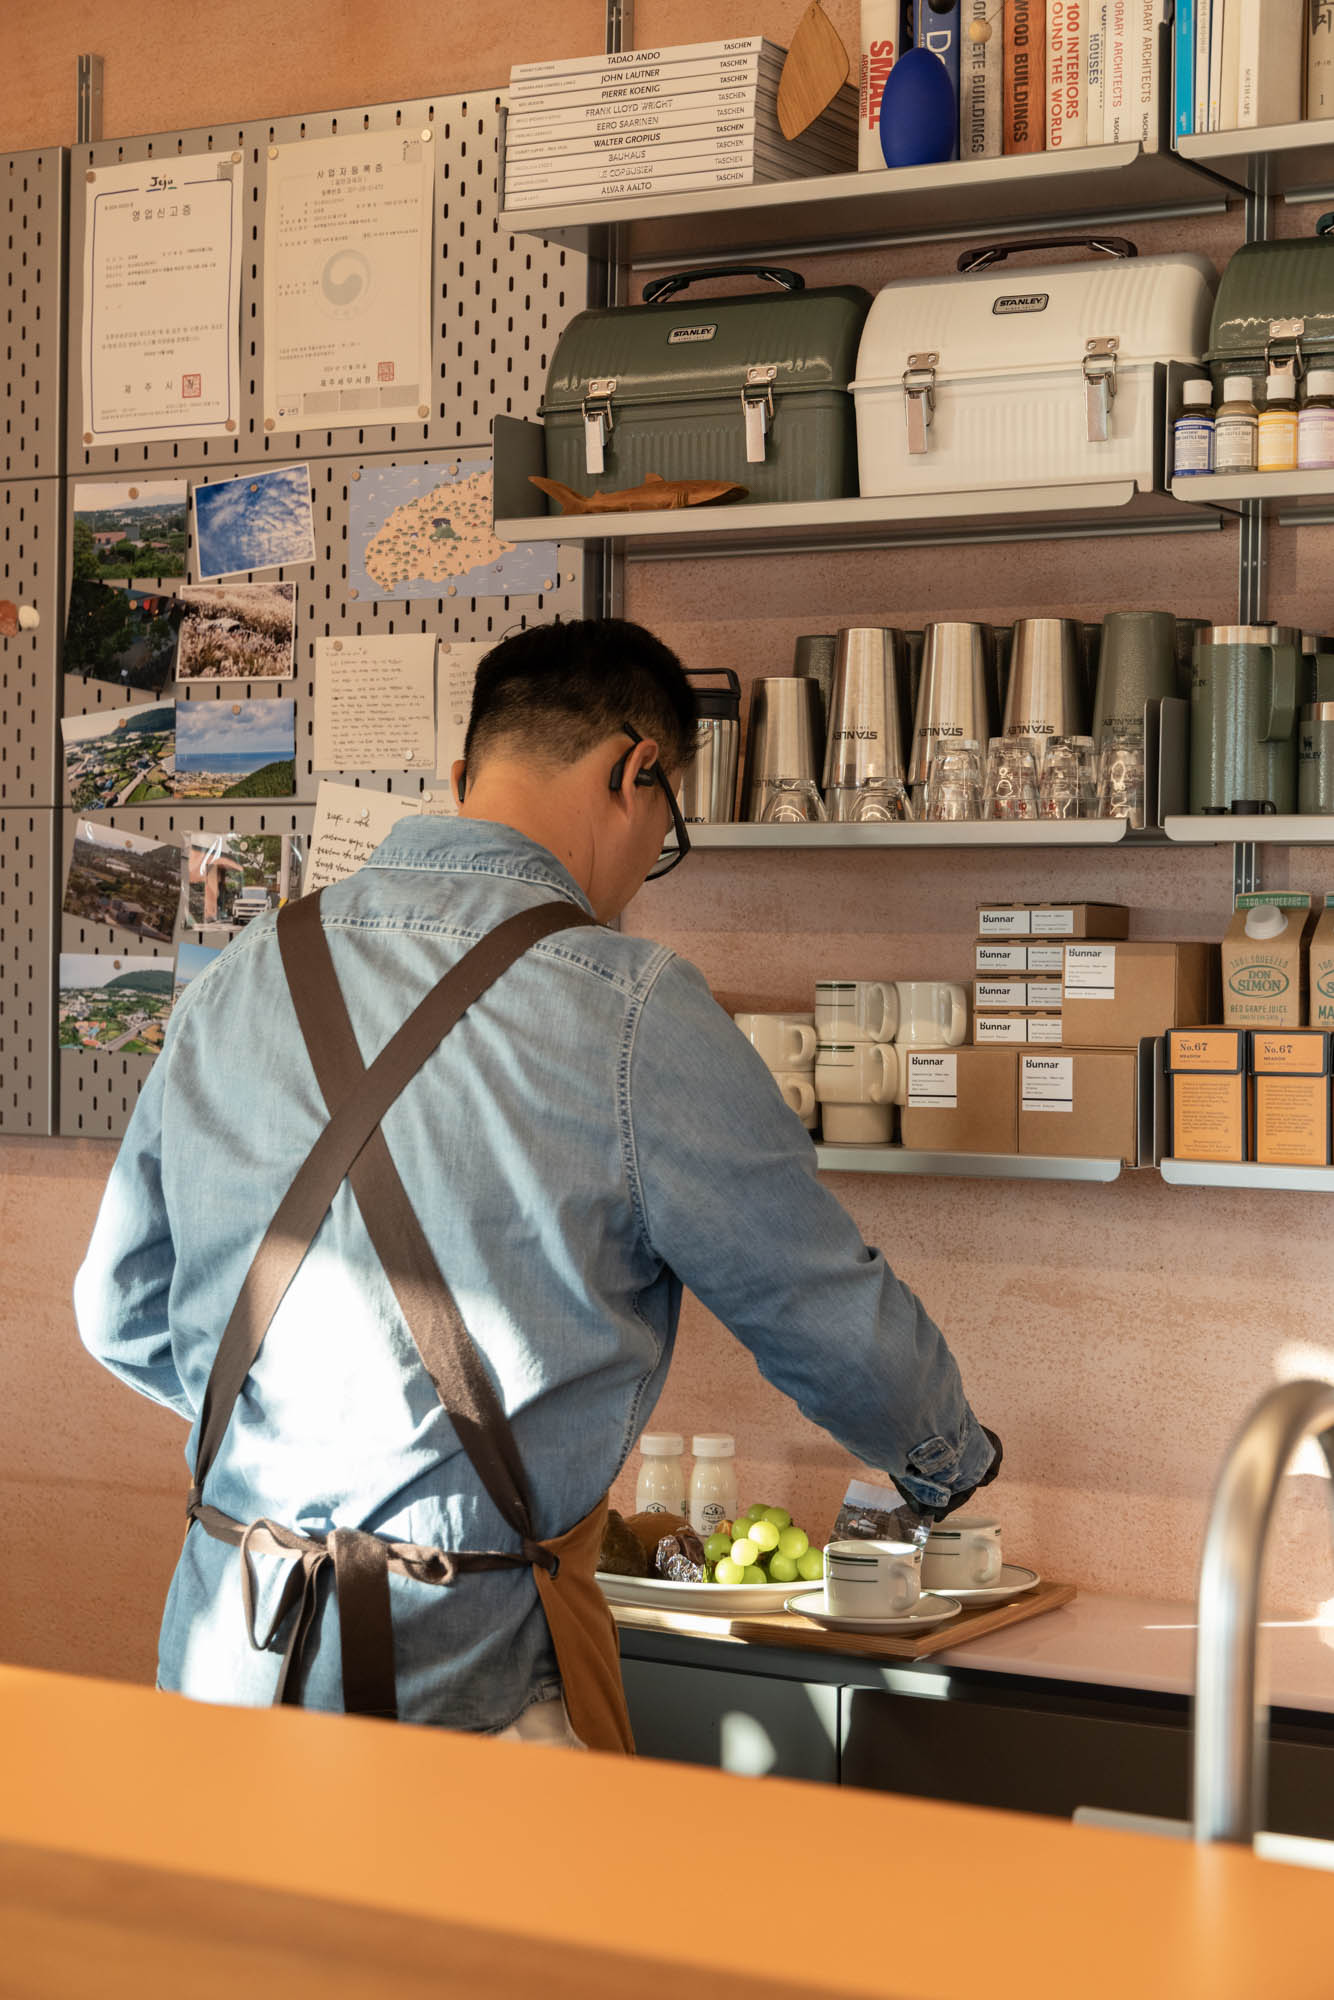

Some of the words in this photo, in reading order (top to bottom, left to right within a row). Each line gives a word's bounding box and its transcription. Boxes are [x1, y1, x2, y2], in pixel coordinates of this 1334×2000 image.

[1066, 3, 1080, 32] 100
[1113, 0, 1124, 37] ORARY
[724, 41, 752, 50] TASCHEN
[607, 54, 633, 64] TADAO
[636, 51, 660, 61] ANDO
[720, 58, 748, 68] TASCHEN
[1089, 33, 1100, 85] HOUSES
[601, 73, 623, 84] JOHN
[625, 69, 660, 79] LAUTNER
[1051, 55, 1063, 85] THE
[1112, 41, 1124, 108] ARCHITECTS
[1140, 37, 1152, 103] ARCHITECTS
[720, 74, 748, 83] TASCHEN
[1066, 36, 1080, 119] INTERIORS
[601, 88, 628, 99] PIERRE
[629, 84, 660, 96] KOENIG
[861, 54, 869, 120] ARCHITECTURE
[718, 91, 746, 100] TASCHEN
[1014, 53, 1029, 143] BUILDINGS
[585, 106, 611, 117] FRANK
[613, 103, 638, 114] LLOYD
[641, 99, 673, 110] WRIGHT
[716, 106, 744, 116] TASCHEN
[971, 75, 986, 153] BUILDINGS
[596, 121, 617, 131] EERO
[619, 116, 659, 128] SAARINEN
[1051, 88, 1063, 147] WORLD
[716, 123, 744, 133] TASCHEN
[593, 137, 623, 148] WALTER
[625, 133, 661, 144] GROPIUS
[716, 140, 744, 149] TASCHEN
[608, 150, 646, 162] BAUHAUS
[149, 174, 174, 191] Jeju
[716, 172, 743, 181] TASCHEN
[601, 185, 625, 195] ALVAR
[626, 181, 652, 192] AALTO
[132, 203, 191, 222] 영업신고증
[1000, 297, 1043, 306] STANLEY
[673, 328, 713, 337] STANLEY
[832, 731, 878, 740] STANLEY
[919, 727, 964, 737] STANLEY
[1008, 725, 1055, 735] STANLEY
[1248, 970, 1272, 979] DON
[1238, 980, 1281, 992] SIMON
